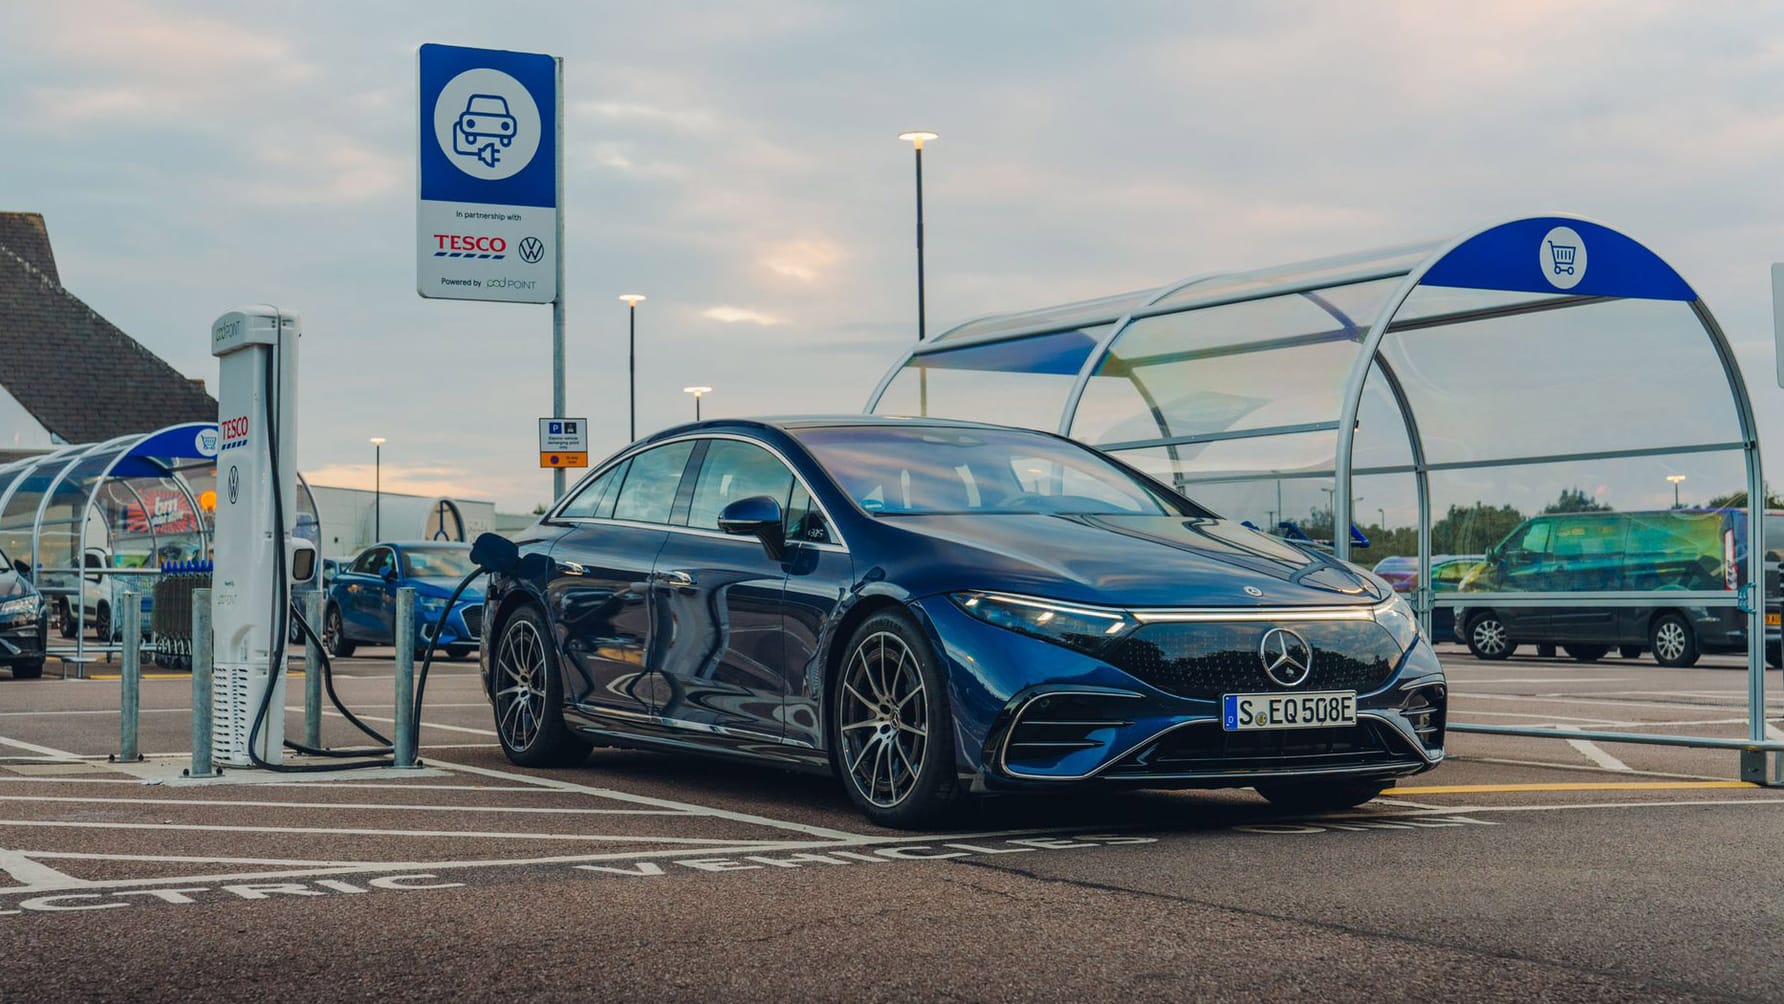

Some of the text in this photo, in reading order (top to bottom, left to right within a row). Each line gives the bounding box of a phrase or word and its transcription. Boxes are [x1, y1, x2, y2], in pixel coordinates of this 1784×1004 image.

[464, 211, 505, 221] partnership
[507, 213, 522, 221] with
[433, 234, 507, 253] TESCO
[441, 277, 472, 287] Powered
[473, 280, 482, 288] by
[221, 415, 249, 440] TESCO
[1239, 700, 1254, 725] S
[0, 873, 467, 916] CTRIC
[572, 833, 1159, 876] VEHICLES
